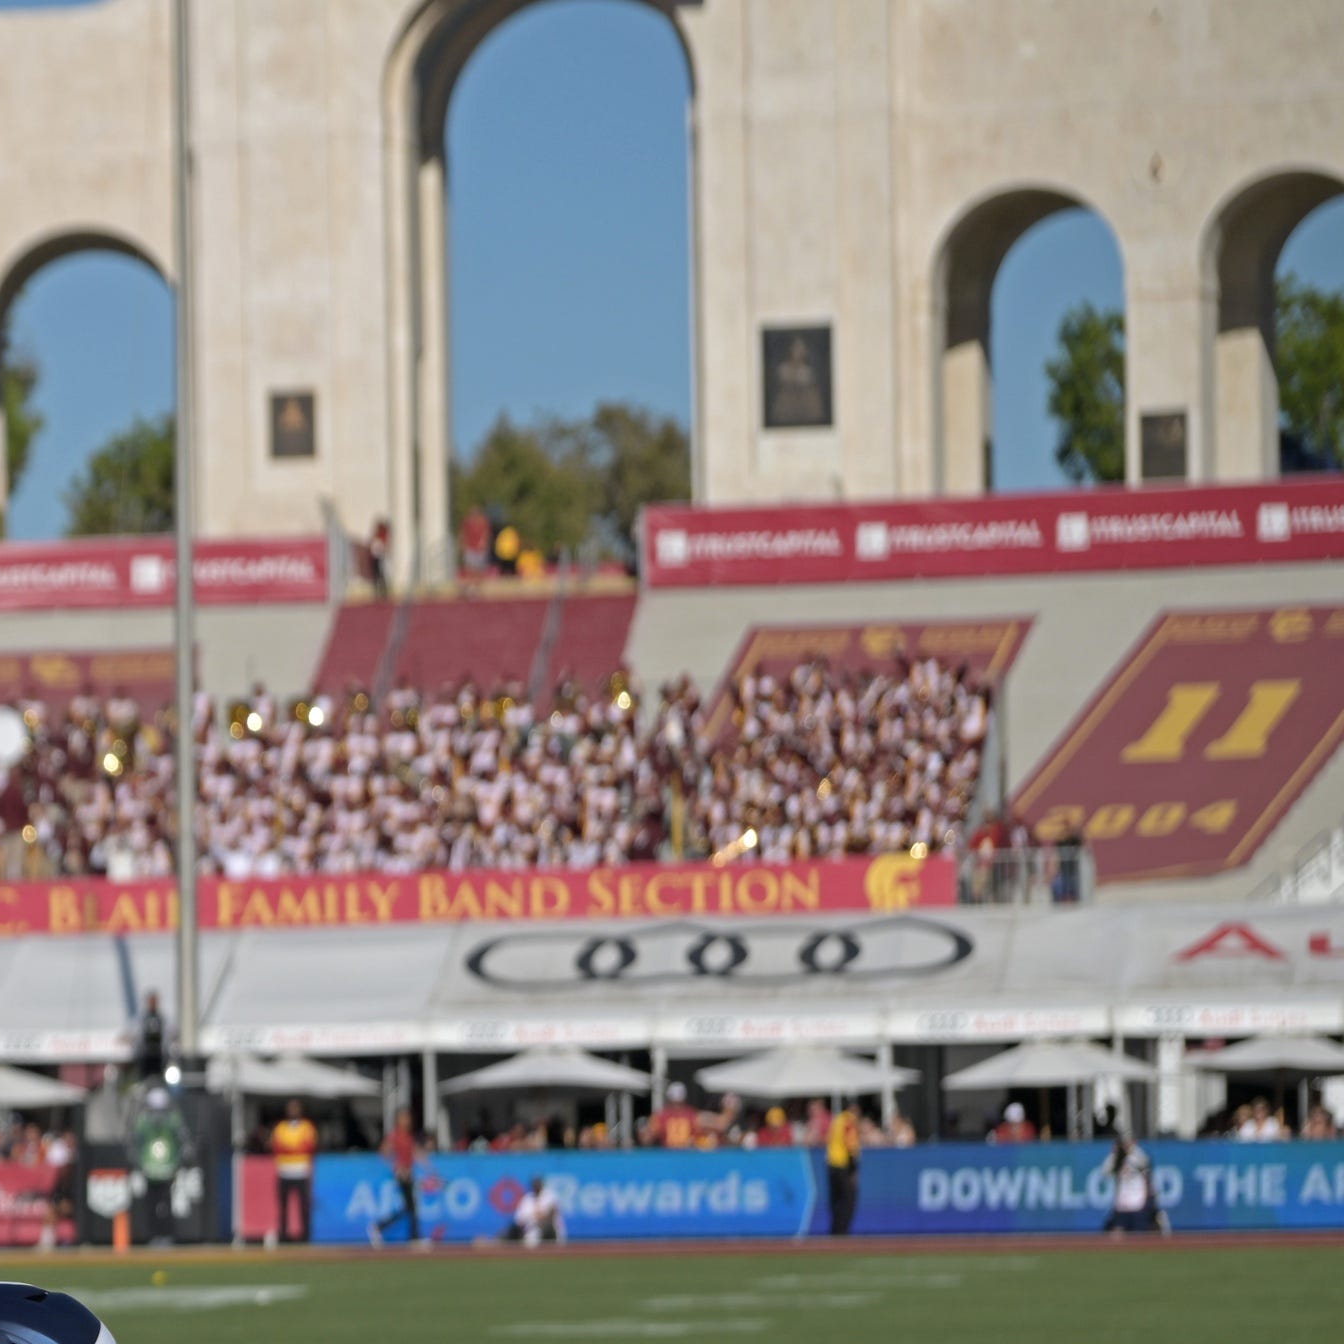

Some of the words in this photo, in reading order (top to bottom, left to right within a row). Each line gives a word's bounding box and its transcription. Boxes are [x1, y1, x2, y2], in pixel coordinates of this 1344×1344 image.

[1119, 679, 1302, 764] 11
[1035, 800, 1238, 842] 2004
[49, 885, 180, 934] BLAI
[217, 880, 400, 925] FAMILY
[419, 873, 571, 919] BAND
[588, 867, 820, 915] SECTION
[545, 1170, 770, 1217] Rewards
[917, 1165, 1182, 1212] DOWNLOD
[1195, 1163, 1289, 1208] THE
